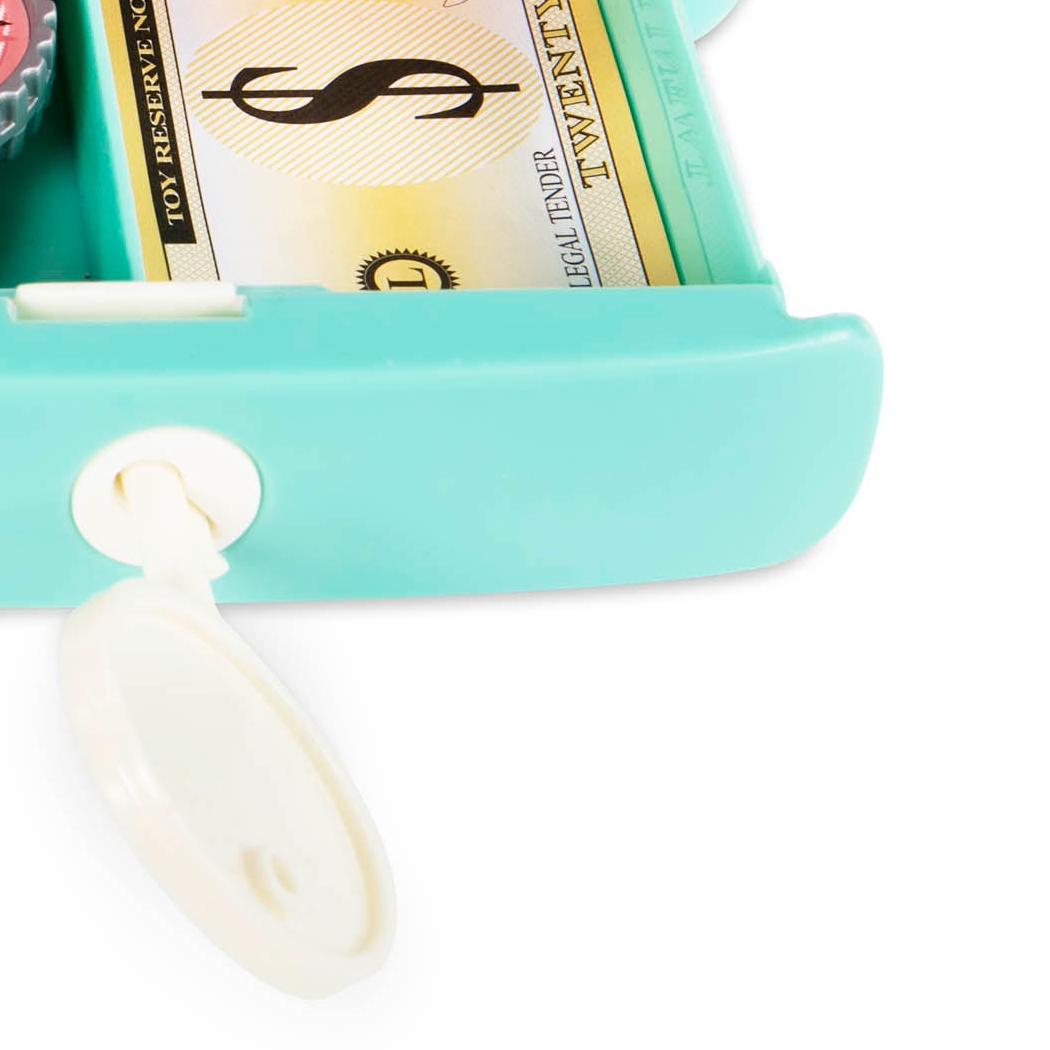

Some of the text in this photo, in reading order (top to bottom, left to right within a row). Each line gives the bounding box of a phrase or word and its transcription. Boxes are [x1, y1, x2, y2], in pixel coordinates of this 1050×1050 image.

[136, 38, 173, 166] RESERVE
[159, 171, 185, 227] TOY
[532, 147, 593, 289] LEGAL TENDER
